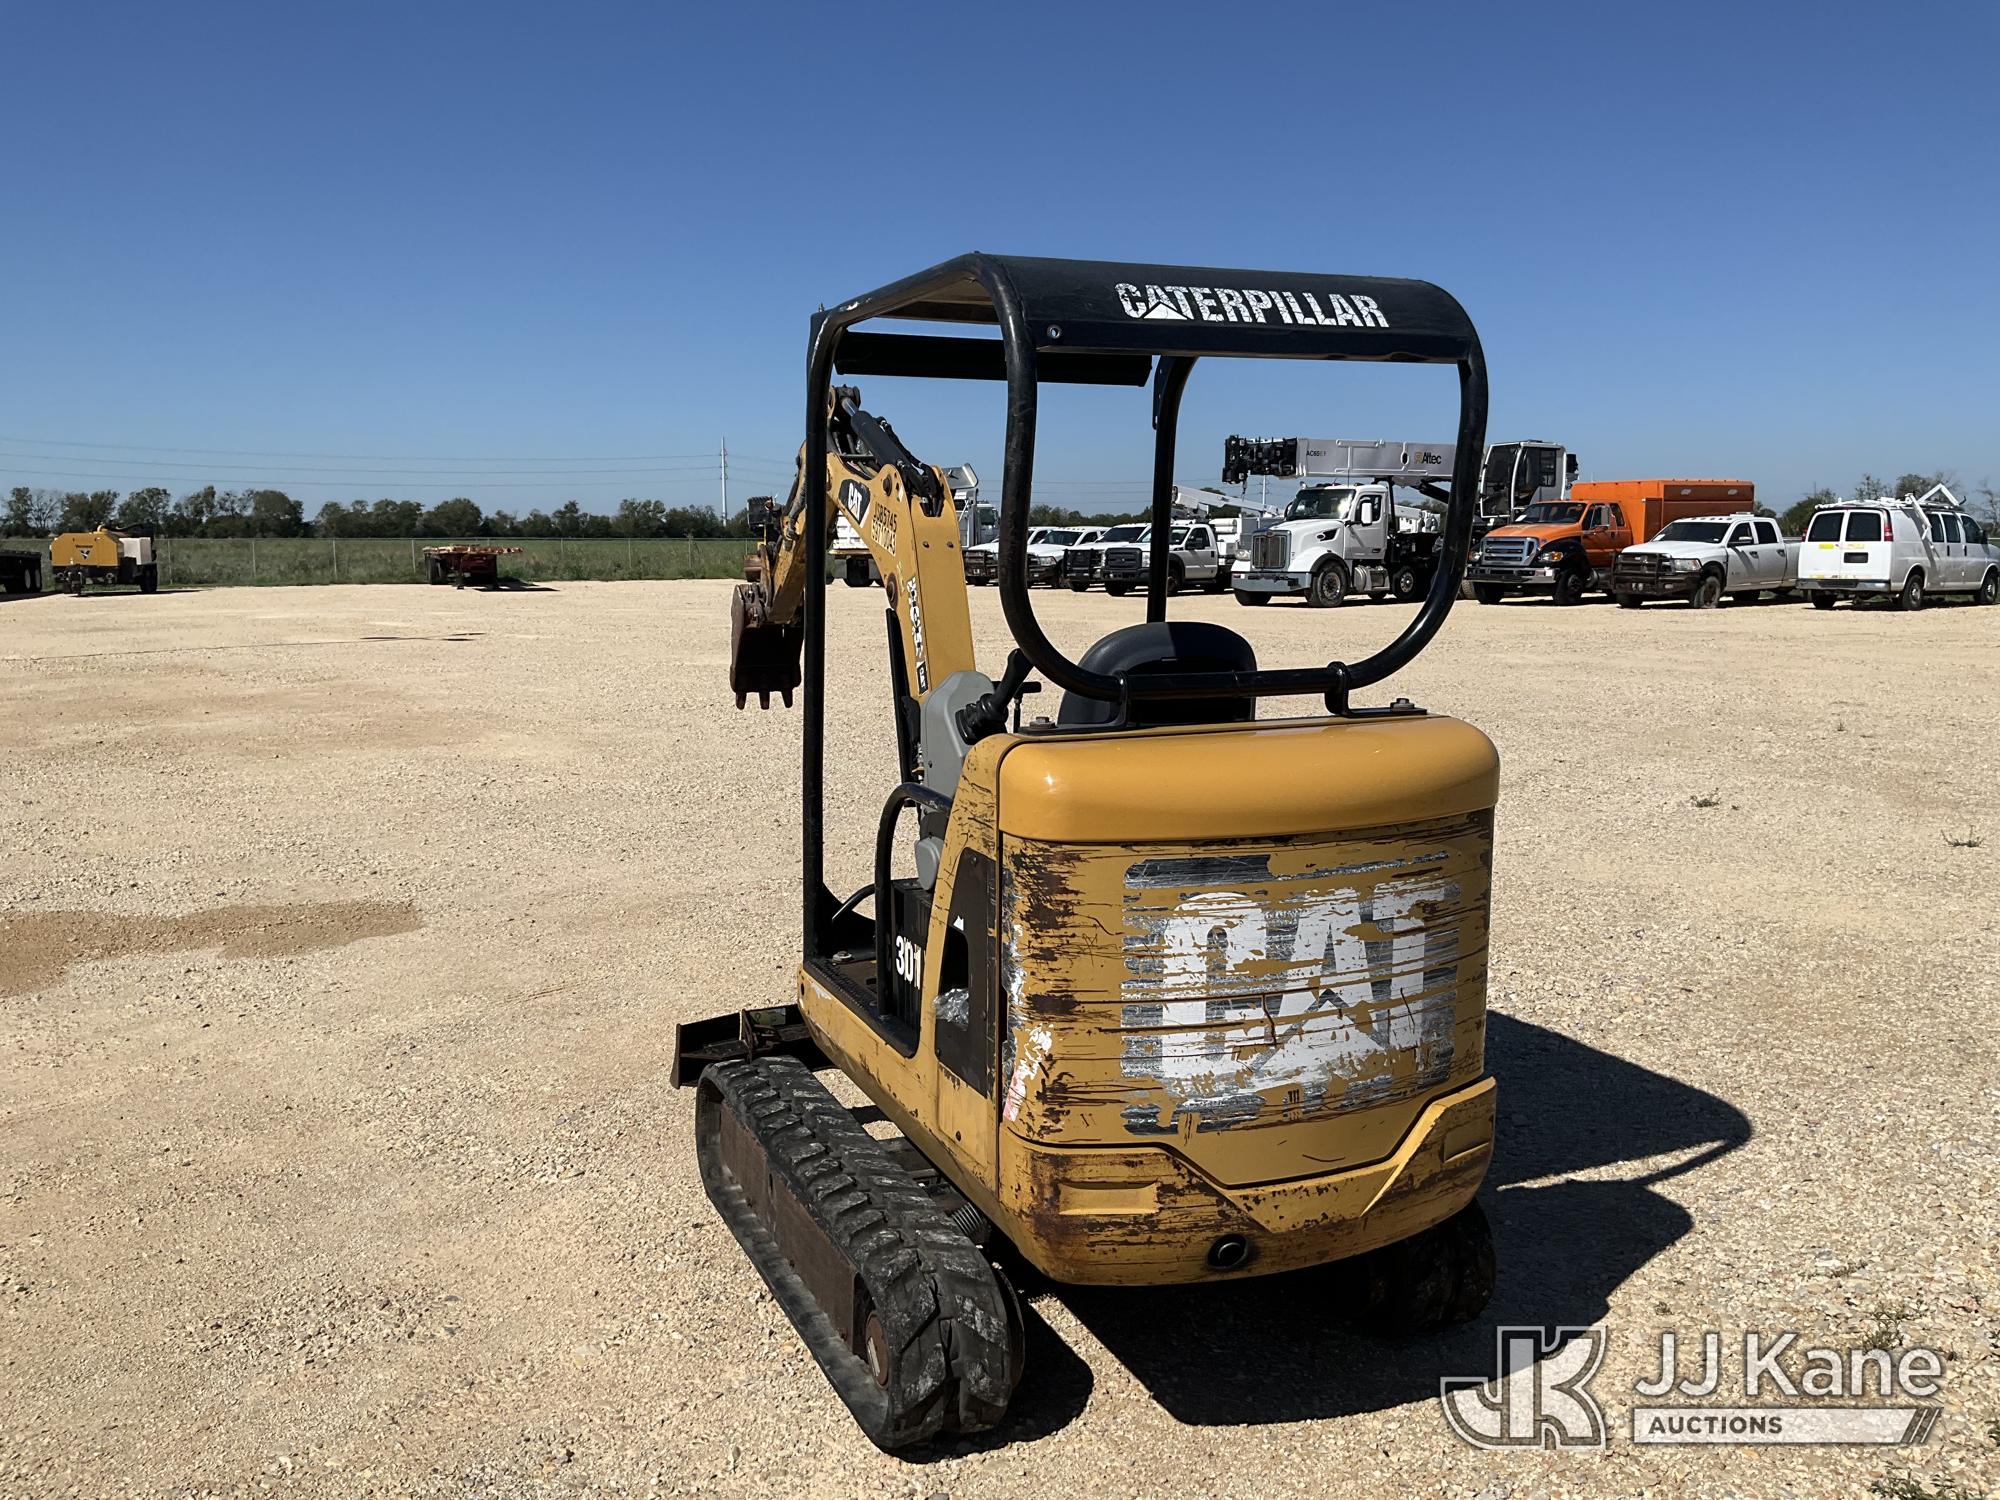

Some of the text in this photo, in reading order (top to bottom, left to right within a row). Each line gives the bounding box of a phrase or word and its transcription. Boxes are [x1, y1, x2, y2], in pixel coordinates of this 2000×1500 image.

[1114, 282, 1390, 327] CATERPILLAR
[1422, 451, 1442, 464] Altec
[847, 482, 863, 521] CAT
[1162, 880, 1445, 1091] CAT
